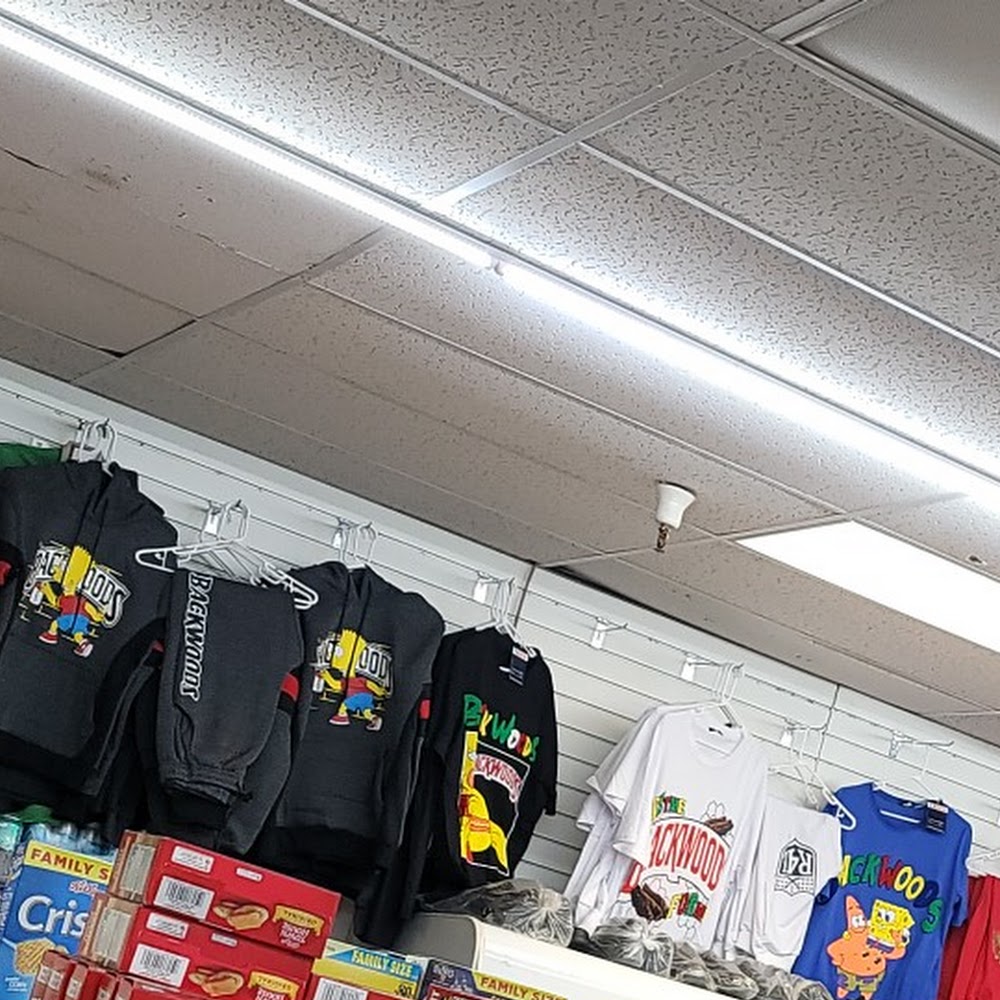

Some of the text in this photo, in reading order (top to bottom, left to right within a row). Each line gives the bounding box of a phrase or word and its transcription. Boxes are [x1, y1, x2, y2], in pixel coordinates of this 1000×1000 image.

[178, 571, 213, 701] BACKWOODS
[31, 848, 94, 875] FAMILY
[18, 895, 89, 938] Cris
[352, 950, 413, 978] FAMILY SIZE
[480, 976, 529, 999] FAMILY
